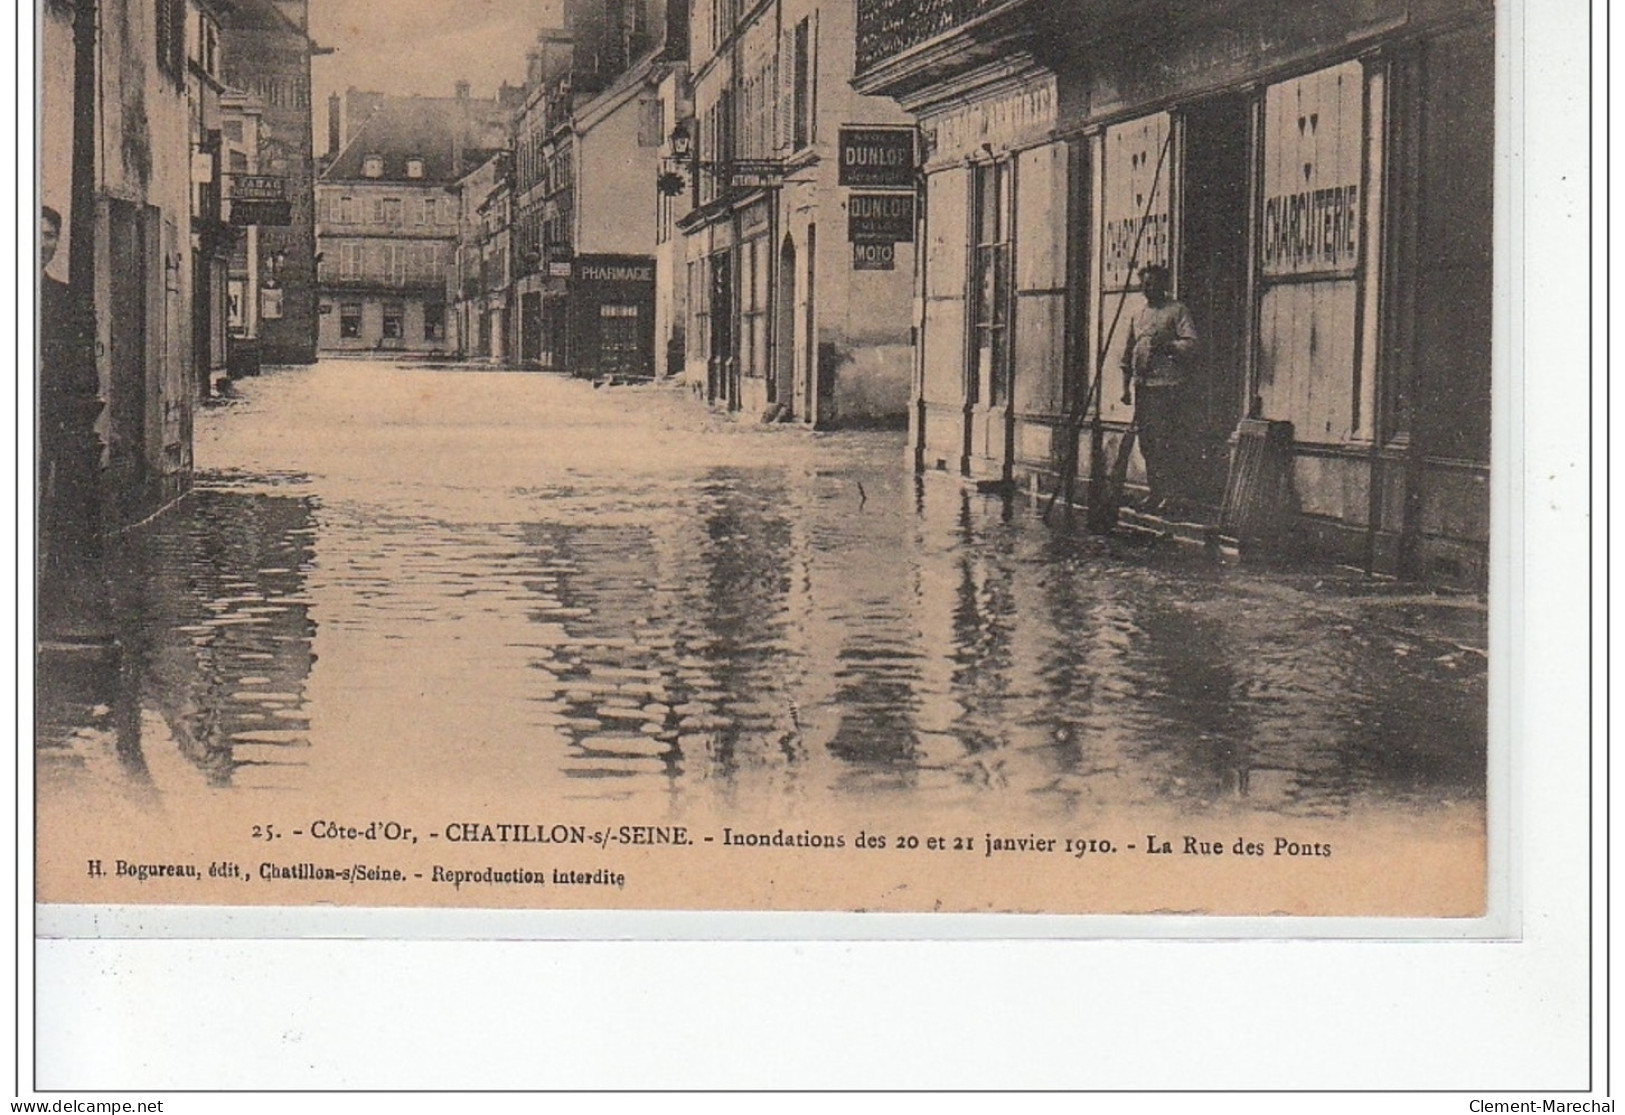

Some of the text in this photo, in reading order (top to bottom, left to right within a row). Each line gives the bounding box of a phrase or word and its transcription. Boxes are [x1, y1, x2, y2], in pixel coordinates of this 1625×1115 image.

[845, 146, 906, 166] DUNLOP
[851, 197, 913, 218] DUNLOP
[1266, 184, 1358, 264] CHARCUTERIE
[854, 245, 894, 262] MOTO
[581, 265, 653, 282] PHARMACIE
